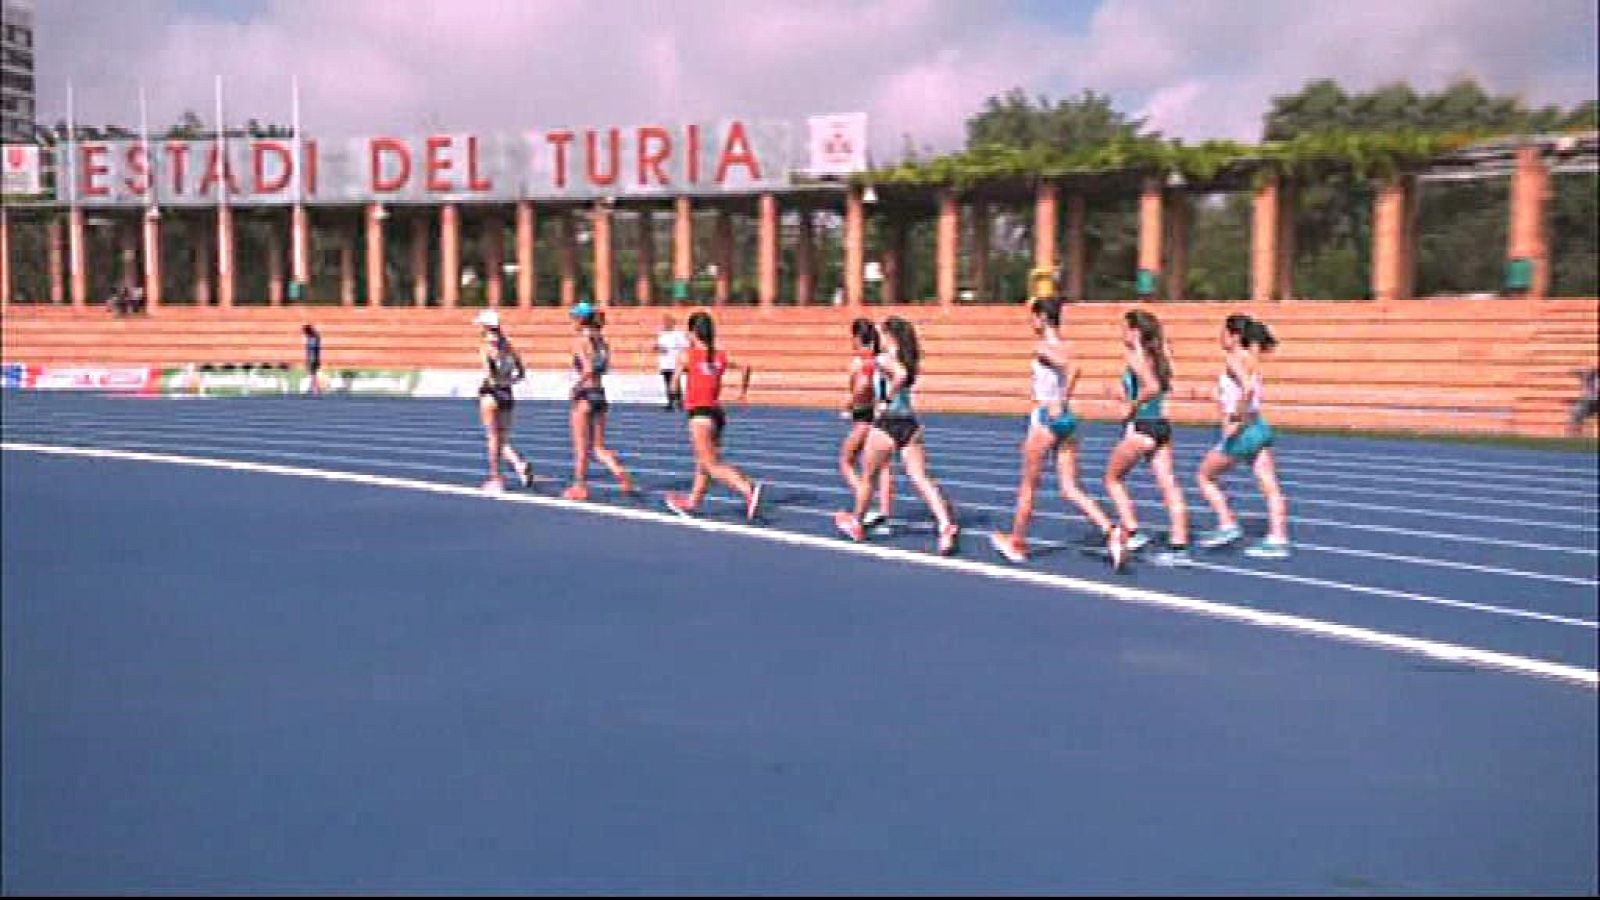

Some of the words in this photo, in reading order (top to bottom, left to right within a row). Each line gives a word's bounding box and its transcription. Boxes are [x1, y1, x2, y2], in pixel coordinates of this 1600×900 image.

[80, 141, 318, 196] ESTADI
[369, 134, 493, 194] DEL
[546, 121, 763, 189] TURIA
